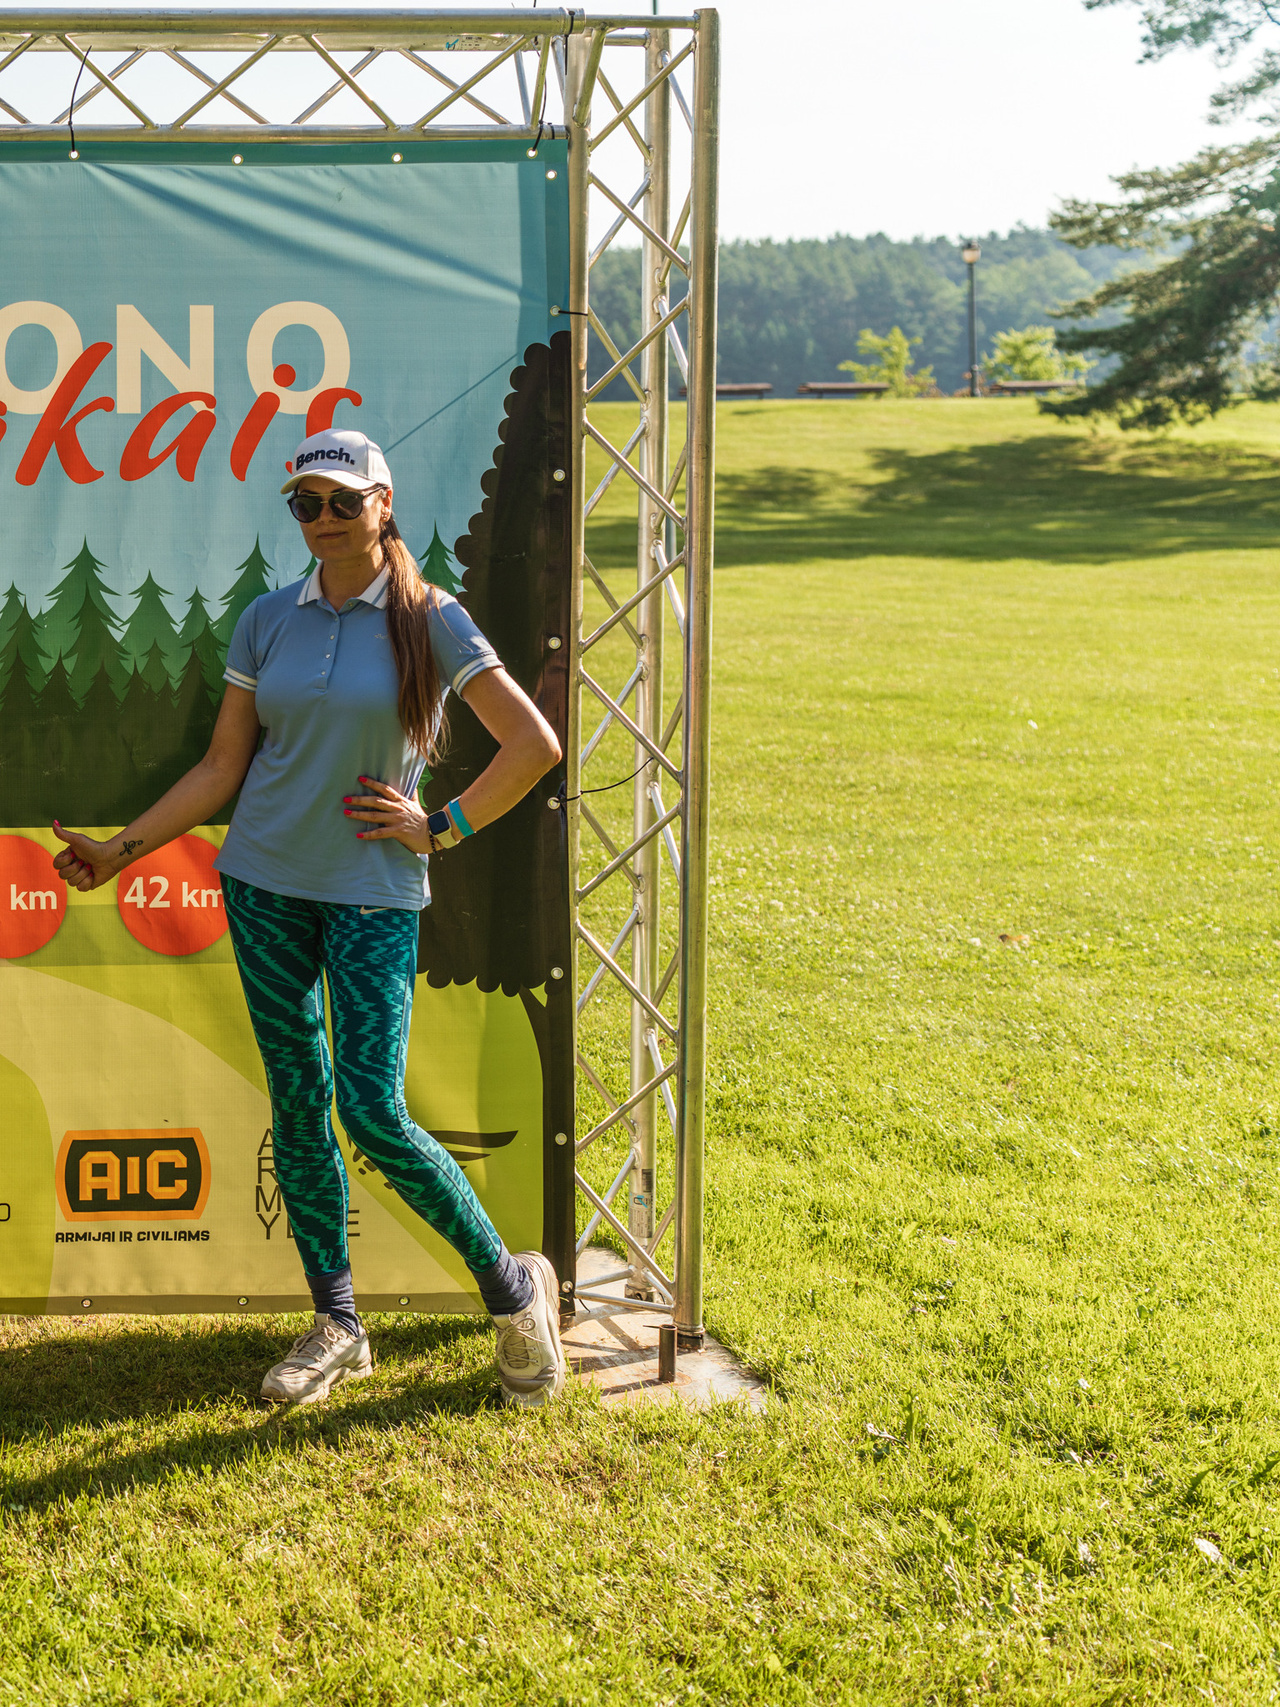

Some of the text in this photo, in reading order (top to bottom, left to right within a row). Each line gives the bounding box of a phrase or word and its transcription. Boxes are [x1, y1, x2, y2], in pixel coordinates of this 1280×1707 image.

[296, 448, 355, 471] Bench.
[10, 884, 57, 911] km
[123, 876, 225, 909] 42 km
[55, 1230, 210, 1243] ARMIJAI IR CIVILIAMS
